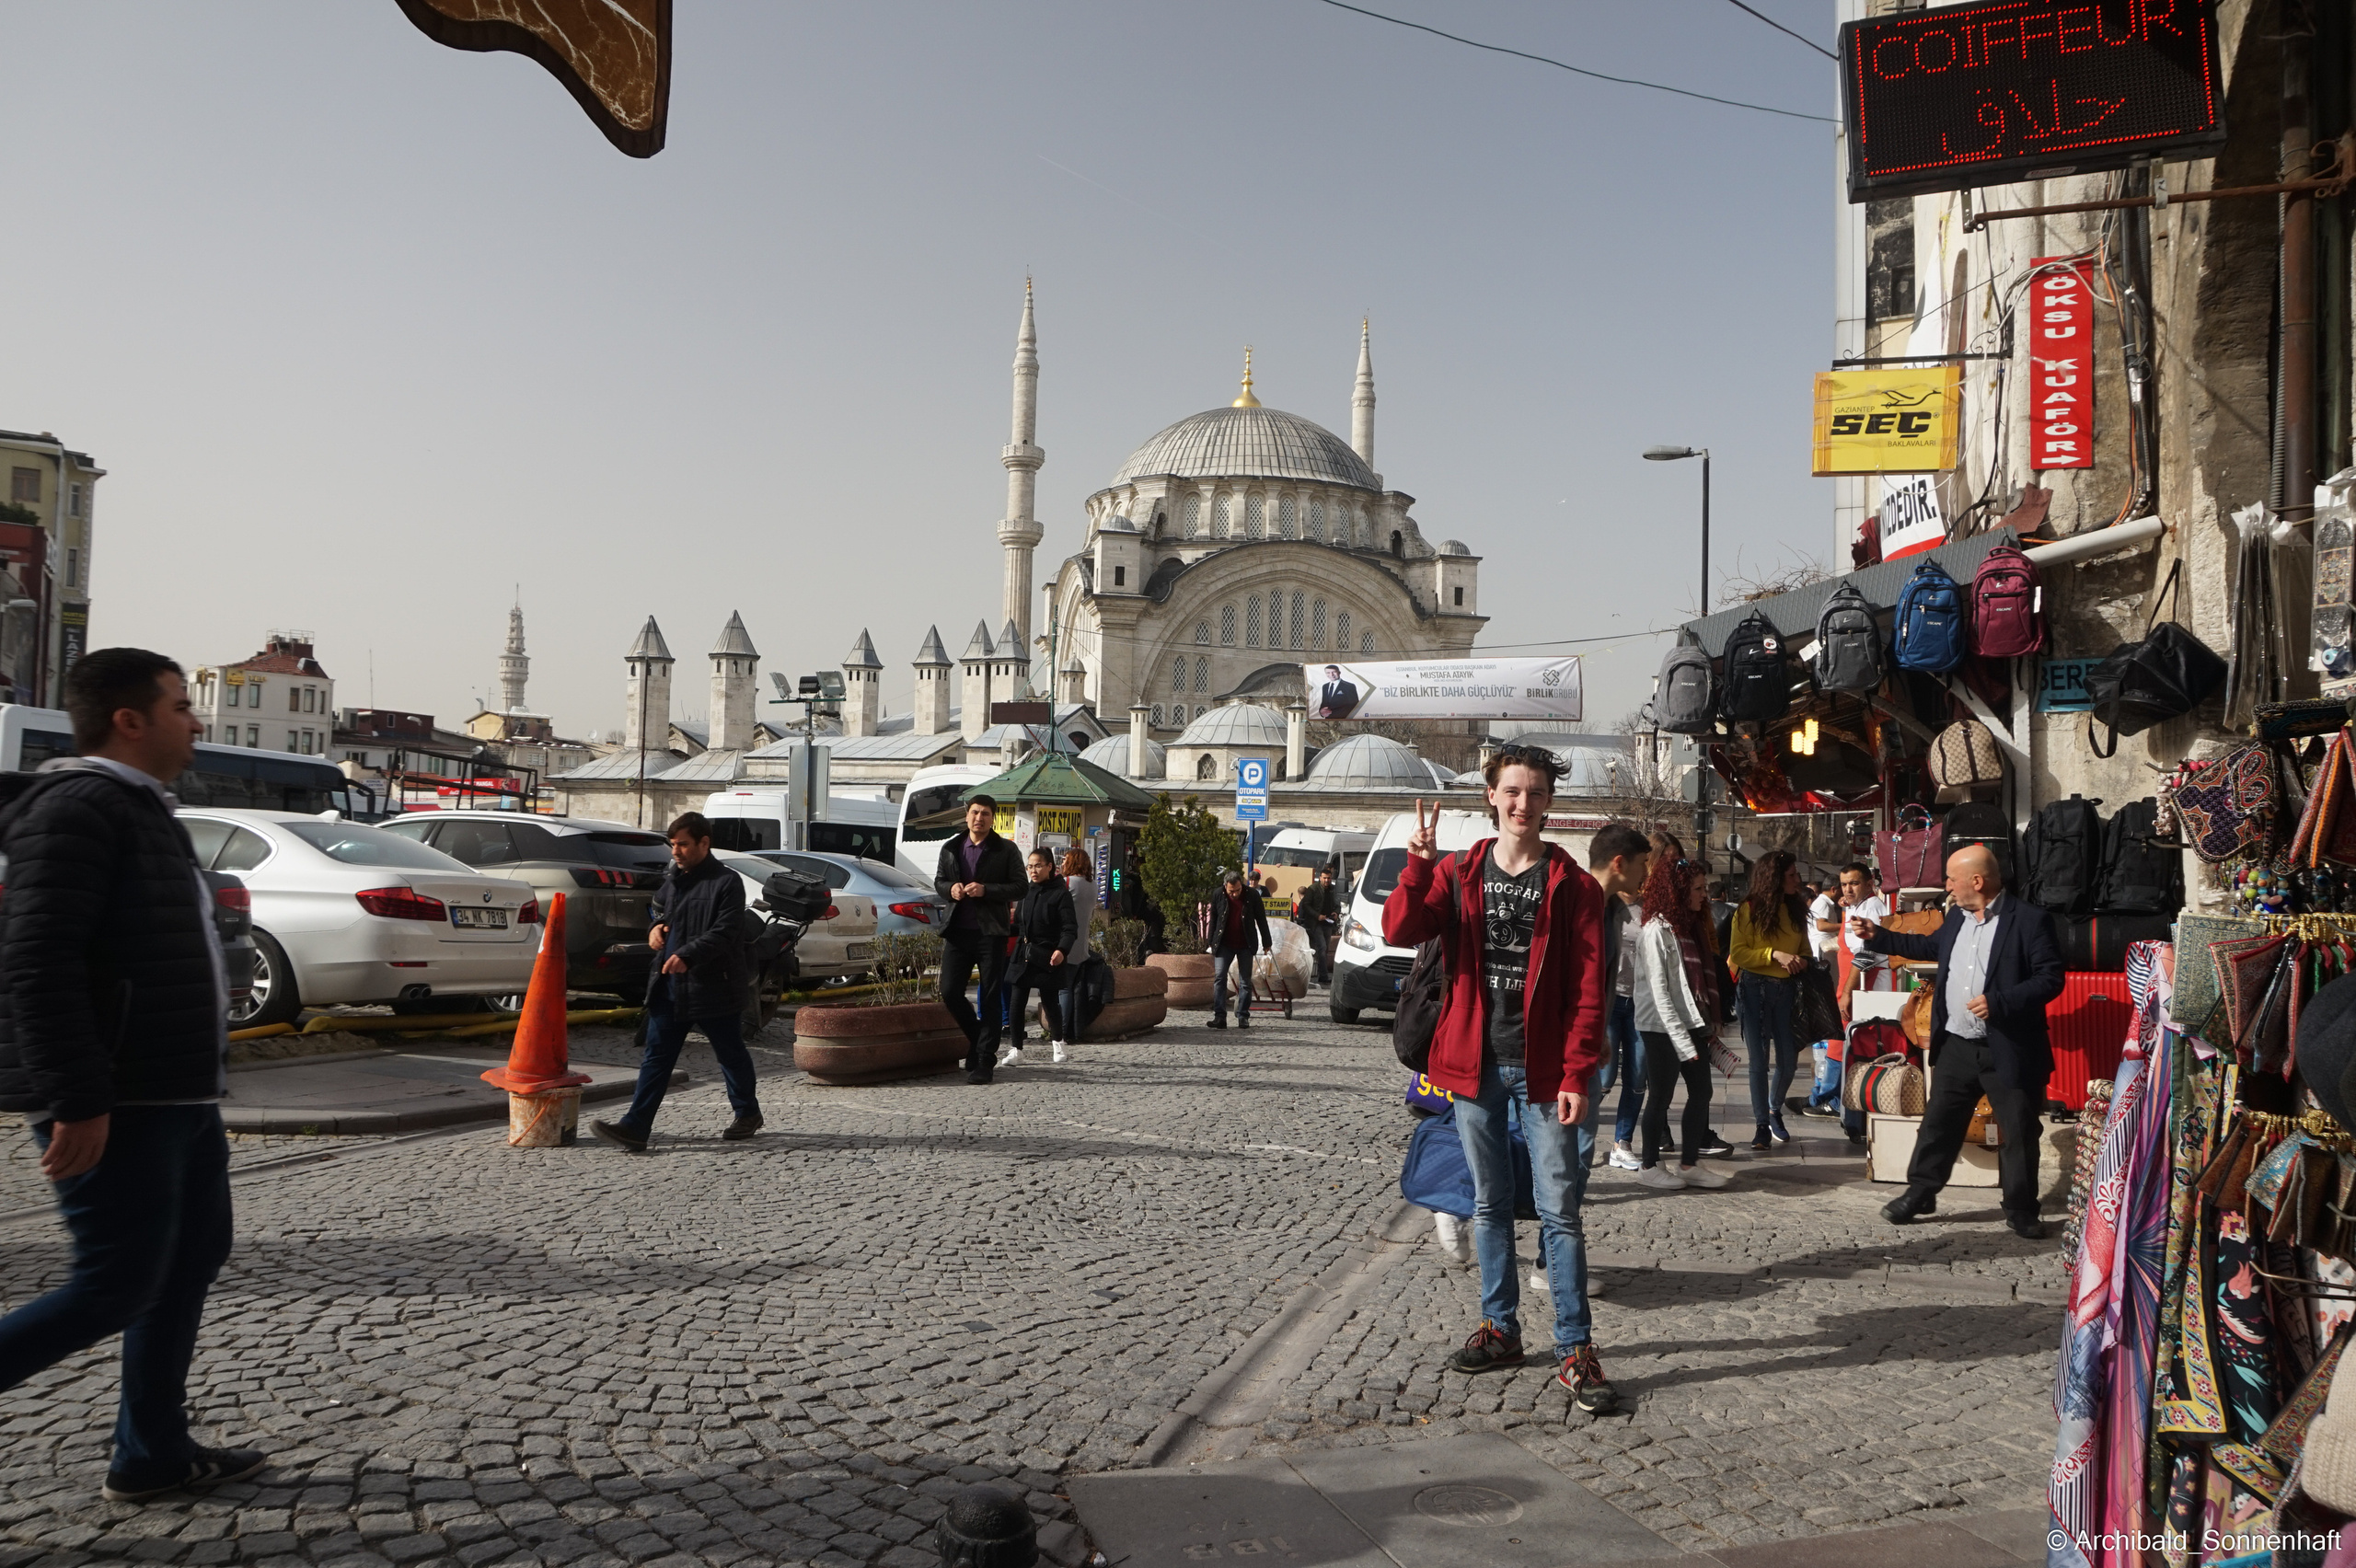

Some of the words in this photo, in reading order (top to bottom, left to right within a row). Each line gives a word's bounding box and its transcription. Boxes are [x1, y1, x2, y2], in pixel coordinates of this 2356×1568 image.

[1873, 0, 2183, 80] COIFFEUR
[1834, 406, 1876, 414] GAZİANTEP
[2042, 358, 2079, 452] KUAFÖR
[1452, 671, 1474, 679] ATAYIK
[1400, 685, 1439, 698] BİRLİKTE
[1441, 686, 1466, 698] DAHA
[1248, 768, 1260, 779] P
[1239, 787, 1265, 795] OTOPARK
[1038, 811, 1057, 832] POST
[1057, 812, 1081, 836] STAMP
[1546, 819, 1572, 827] ANGE
[457, 909, 469, 922] 34
[471, 909, 483, 923] NK
